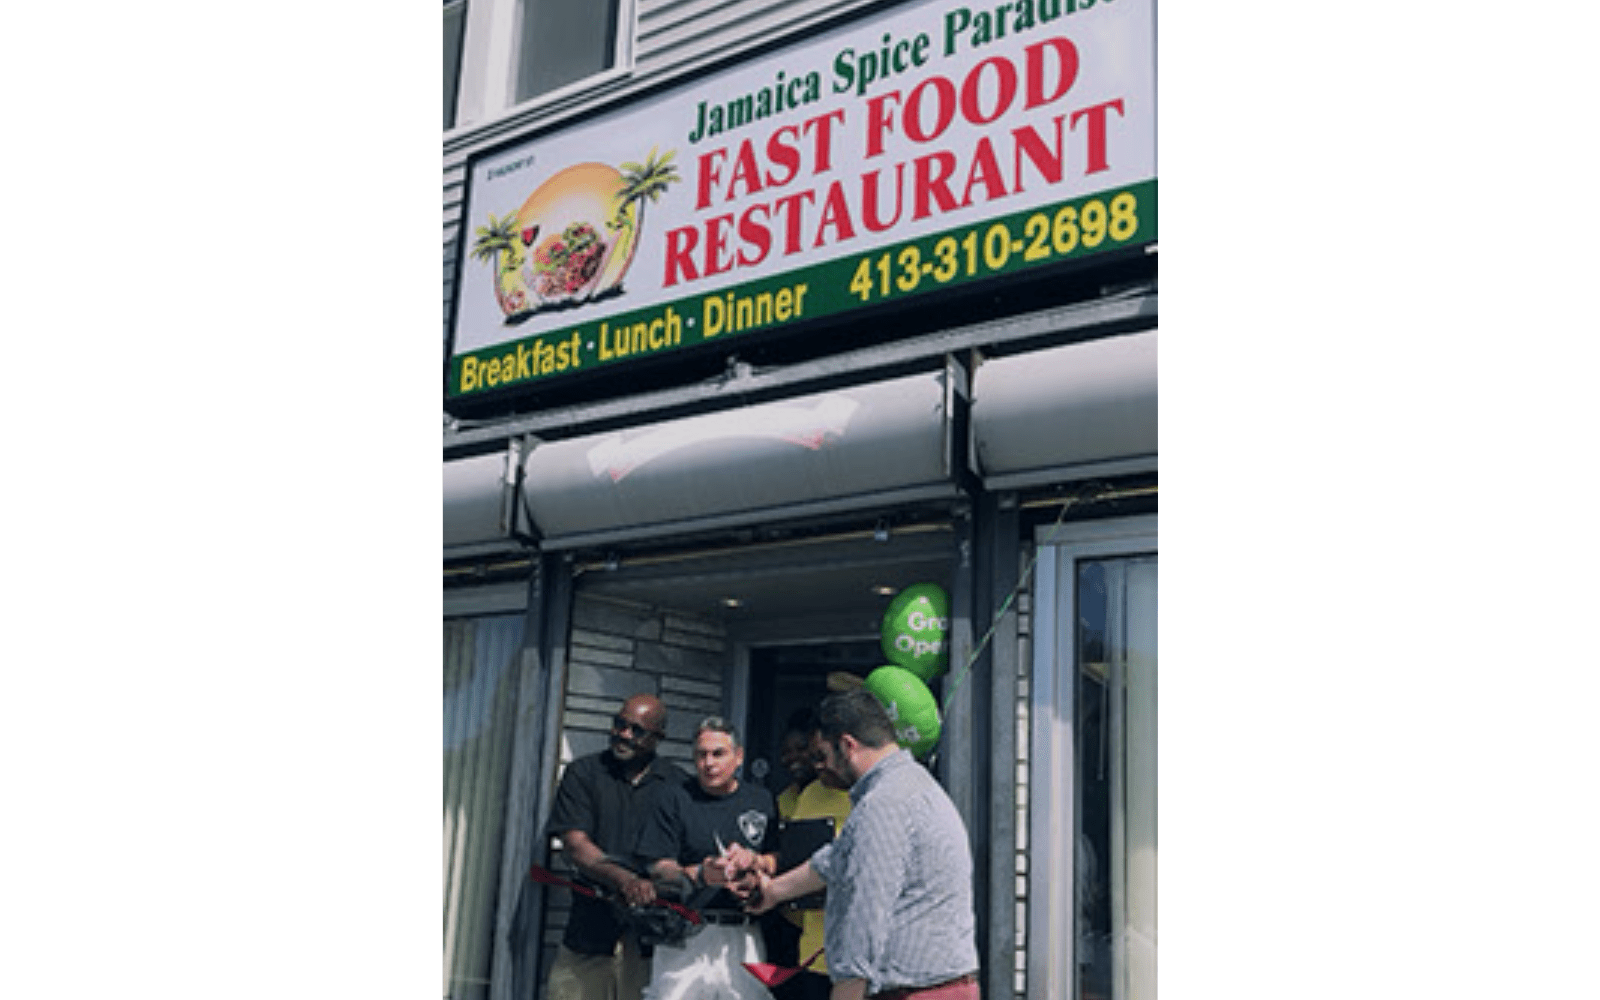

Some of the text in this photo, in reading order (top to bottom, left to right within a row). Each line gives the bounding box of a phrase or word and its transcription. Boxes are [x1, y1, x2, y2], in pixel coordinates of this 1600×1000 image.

[688, 0, 1113, 143] Jamaica Spice Para
[695, 37, 1080, 211] FAST FOOD
[662, 98, 1125, 288] RESTAURANT
[459, 192, 1138, 393] Breakfast Lunch Dinner 413-310-2698
